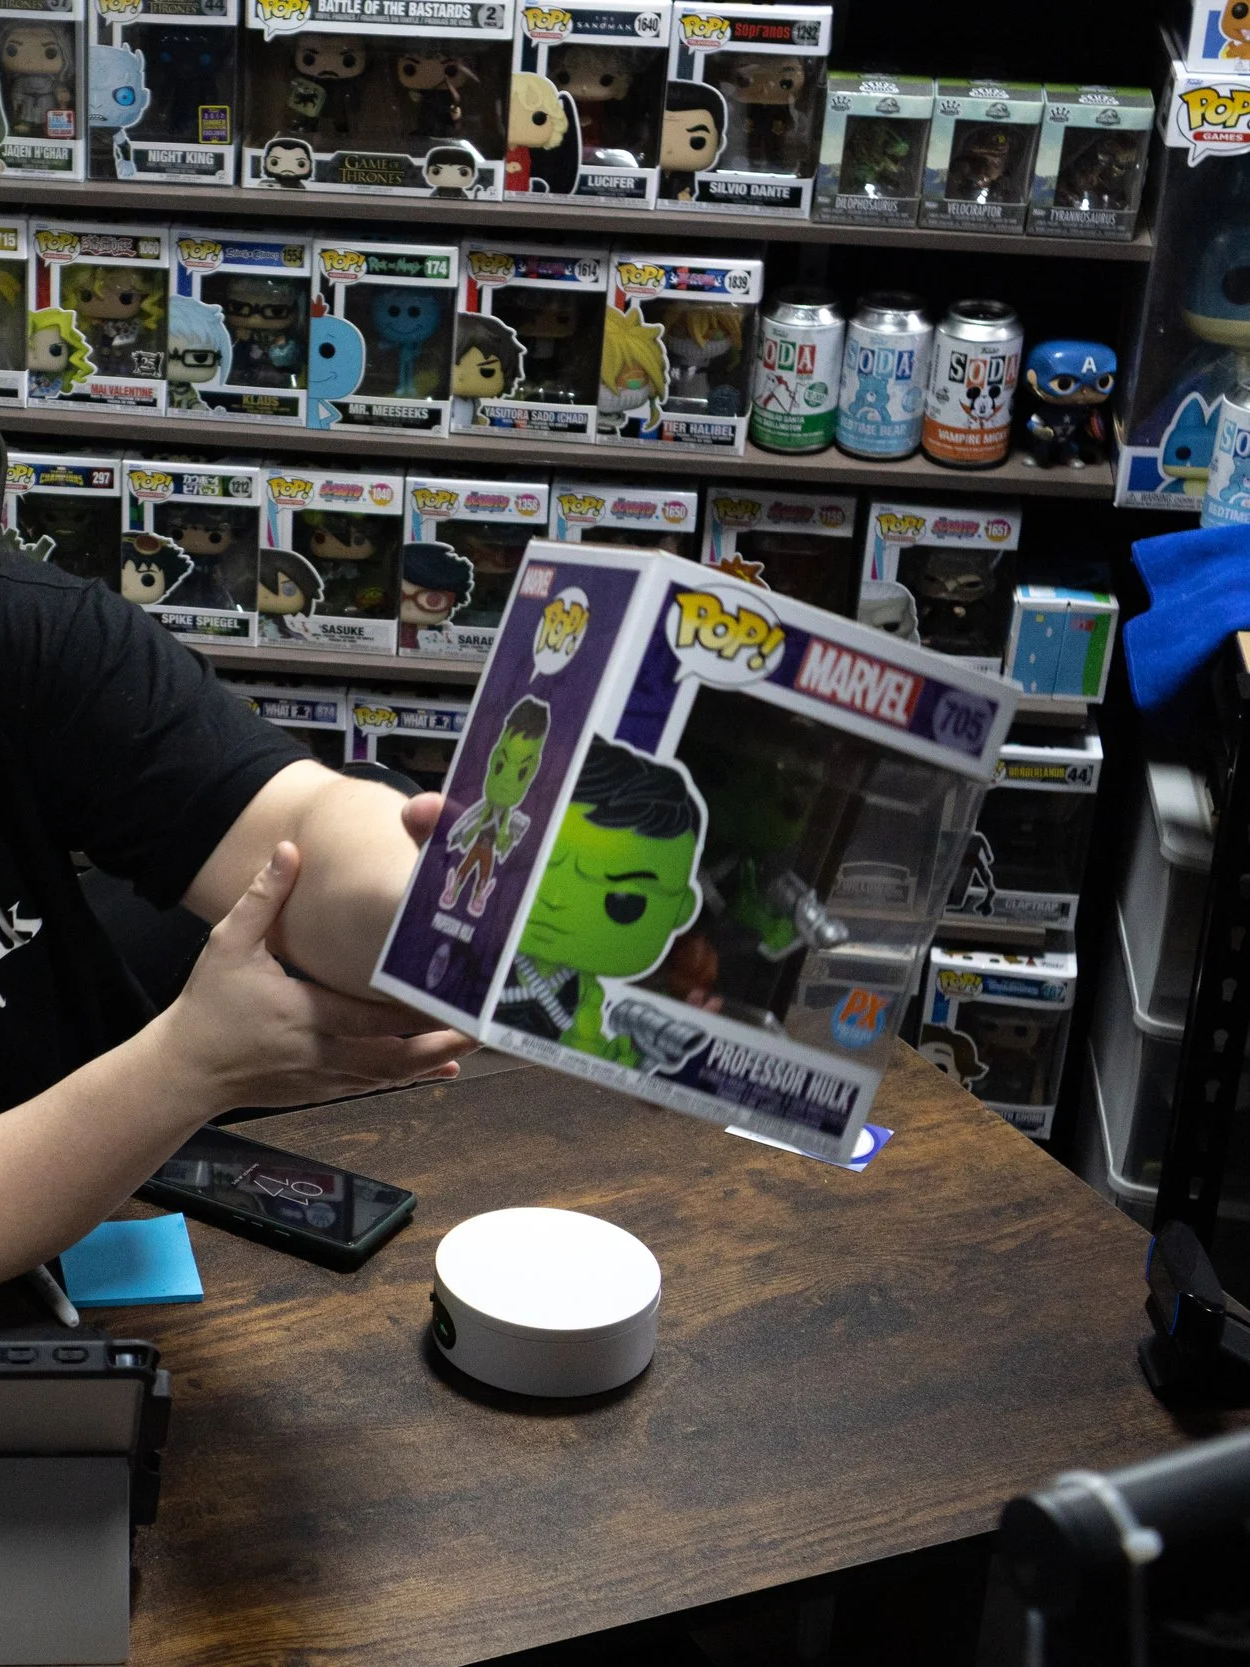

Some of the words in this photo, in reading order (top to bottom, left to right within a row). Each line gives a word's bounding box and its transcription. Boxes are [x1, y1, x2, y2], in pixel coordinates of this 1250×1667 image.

[149, 2, 198, 13] THRONES
[318, 0, 361, 14] BATTLE
[364, 1, 381, 15] OF
[382, 2, 405, 17] THE
[408, 3, 471, 20] BASTARDS
[486, 7, 497, 20] 2
[522, 8, 572, 31] POP!
[637, 18, 660, 32] 1640
[797, 25, 819, 41] 1292
[1179, 88, 1250, 130] POP
[1202, 131, 1243, 142] GAMES
[2, 143, 32, 159] JAQEN
[34, 145, 69, 160] H'GHAR
[148, 149, 182, 164] NIGHT
[186, 152, 215, 166] KING
[345, 156, 388, 170] GAME
[340, 170, 403, 184] THRONES
[587, 174, 635, 189] LUCIFER
[709, 181, 748, 196] SILVIO
[750, 184, 791, 199] DANTE
[947, 202, 1002, 218] VELOCIRAPTOR
[1050, 208, 1116, 226] TYRANNOSAURUS
[35, 230, 80, 254] POP!
[282, 247, 303, 264] 1554
[319, 248, 367, 271] POP!
[425, 259, 448, 275] 174
[577, 262, 598, 278] 1614
[728, 273, 749, 289] 1839
[846, 340, 914, 381] SODA
[949, 349, 1019, 388] SODA
[1081, 356, 1097, 374] A
[91, 383, 106, 396] MAI
[107, 384, 153, 398] VALENTINE
[242, 394, 279, 407] KLAUS
[349, 403, 369, 416] MR.
[372, 404, 429, 421] MEESEEKS
[485, 406, 529, 421] YASUTORA
[531, 410, 555, 422] SADO
[557, 411, 588, 425] (CHAD)
[663, 420, 686, 433] TIER
[689, 422, 734, 437] HALIBEL
[880, 423, 908, 438] BEAR
[938, 427, 981, 445] VAMPIRE
[92, 471, 110, 485] 297
[128, 470, 172, 494] POP!
[230, 478, 250, 494] 1212
[268, 476, 312, 500] POP!
[558, 493, 606, 516] POP!
[878, 512, 926, 536] POP!
[161, 613, 193, 626] SPIKE
[196, 615, 240, 629] SPIEGEL
[541, 599, 590, 656] POP!
[321, 624, 365, 637] SASUKE
[674, 590, 786, 670] POP!
[802, 645, 917, 724] MARVEL
[264, 703, 289, 718] WHAT
[353, 704, 397, 727] POP!
[402, 713, 430, 727] WHAT
[940, 698, 987, 746] 705
[1067, 766, 1089, 783] 44
[938, 968, 983, 994] POP!
[839, 986, 888, 1031] PX
[707, 1036, 807, 1097] PROFESSOR
[806, 1070, 858, 1115] HULK
